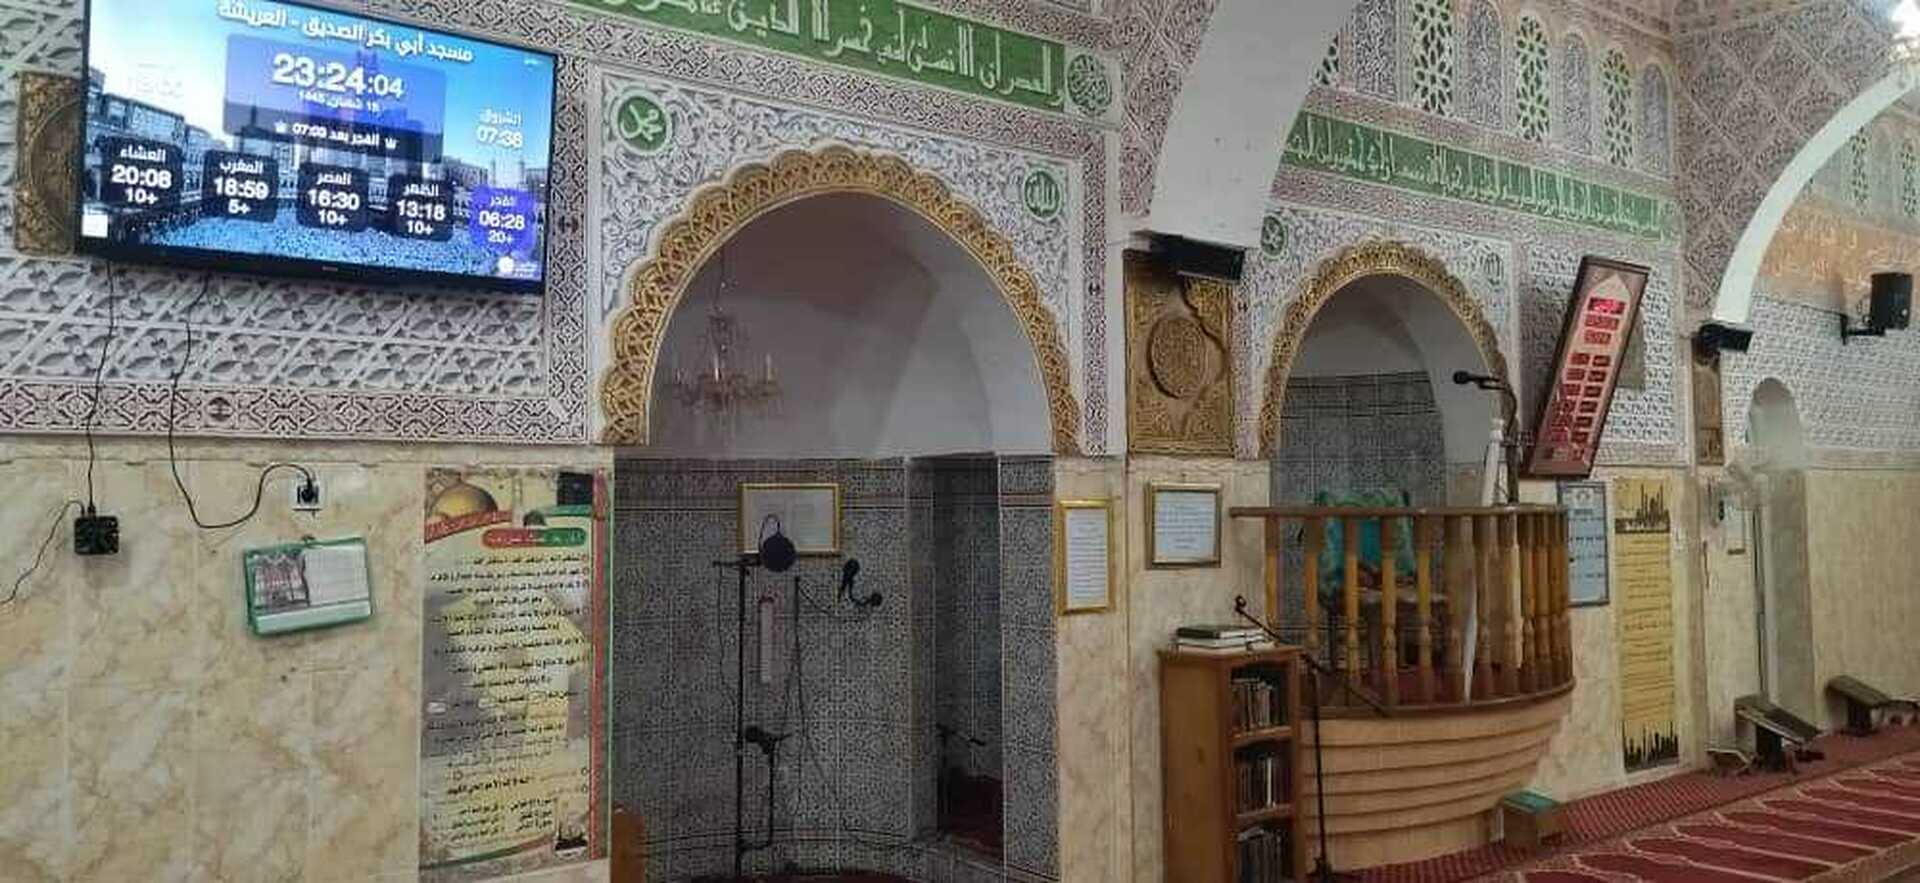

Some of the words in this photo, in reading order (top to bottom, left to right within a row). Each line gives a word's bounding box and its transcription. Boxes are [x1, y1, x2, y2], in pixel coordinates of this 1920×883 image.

[302, 16, 363, 42] الصديق
[367, 28, 391, 50] بكر
[396, 32, 424, 57] أبي
[427, 42, 474, 63] مسجد
[273, 52, 404, 99] 23:24:04
[329, 129, 350, 143] بعد
[352, 133, 381, 148] الفجر
[477, 127, 525, 150] 07:38
[119, 145, 167, 163] العشاء
[111, 164, 172, 189] 20:08
[219, 158, 264, 175] المغرب
[213, 176, 269, 200] 18:59
[316, 172, 352, 185] العصر
[307, 189, 360, 211] 16:30
[403, 182, 440, 198] الظهر
[396, 199, 446, 221] 13:18
[478, 210, 526, 231] 06:28
